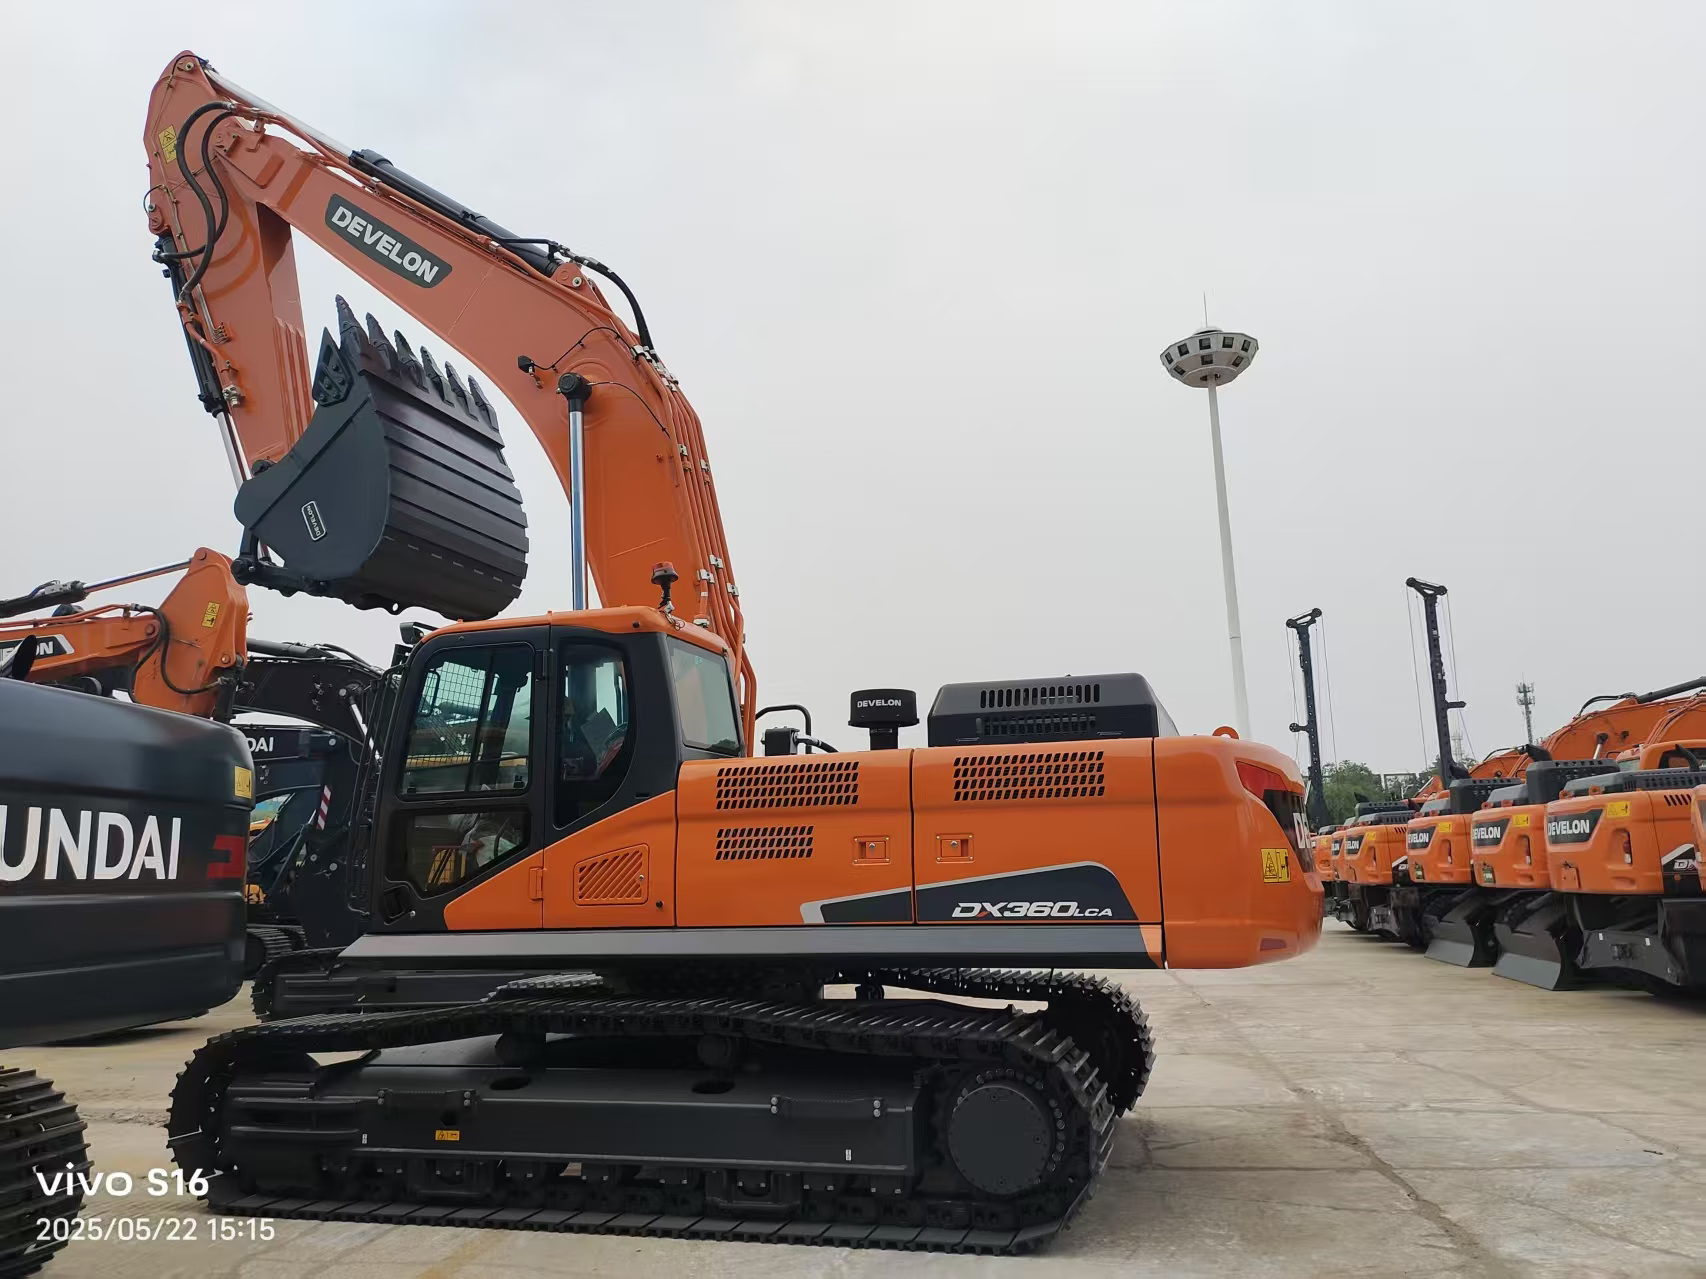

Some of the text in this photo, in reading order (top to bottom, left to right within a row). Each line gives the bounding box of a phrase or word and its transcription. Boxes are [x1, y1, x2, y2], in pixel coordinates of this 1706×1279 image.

[331, 205, 440, 284] DEVELON
[306, 504, 321, 537] DEVELON
[857, 699, 902, 708] DEVELON
[1547, 819, 1590, 836] DEVELON
[951, 901, 1113, 918] DX360LCA
